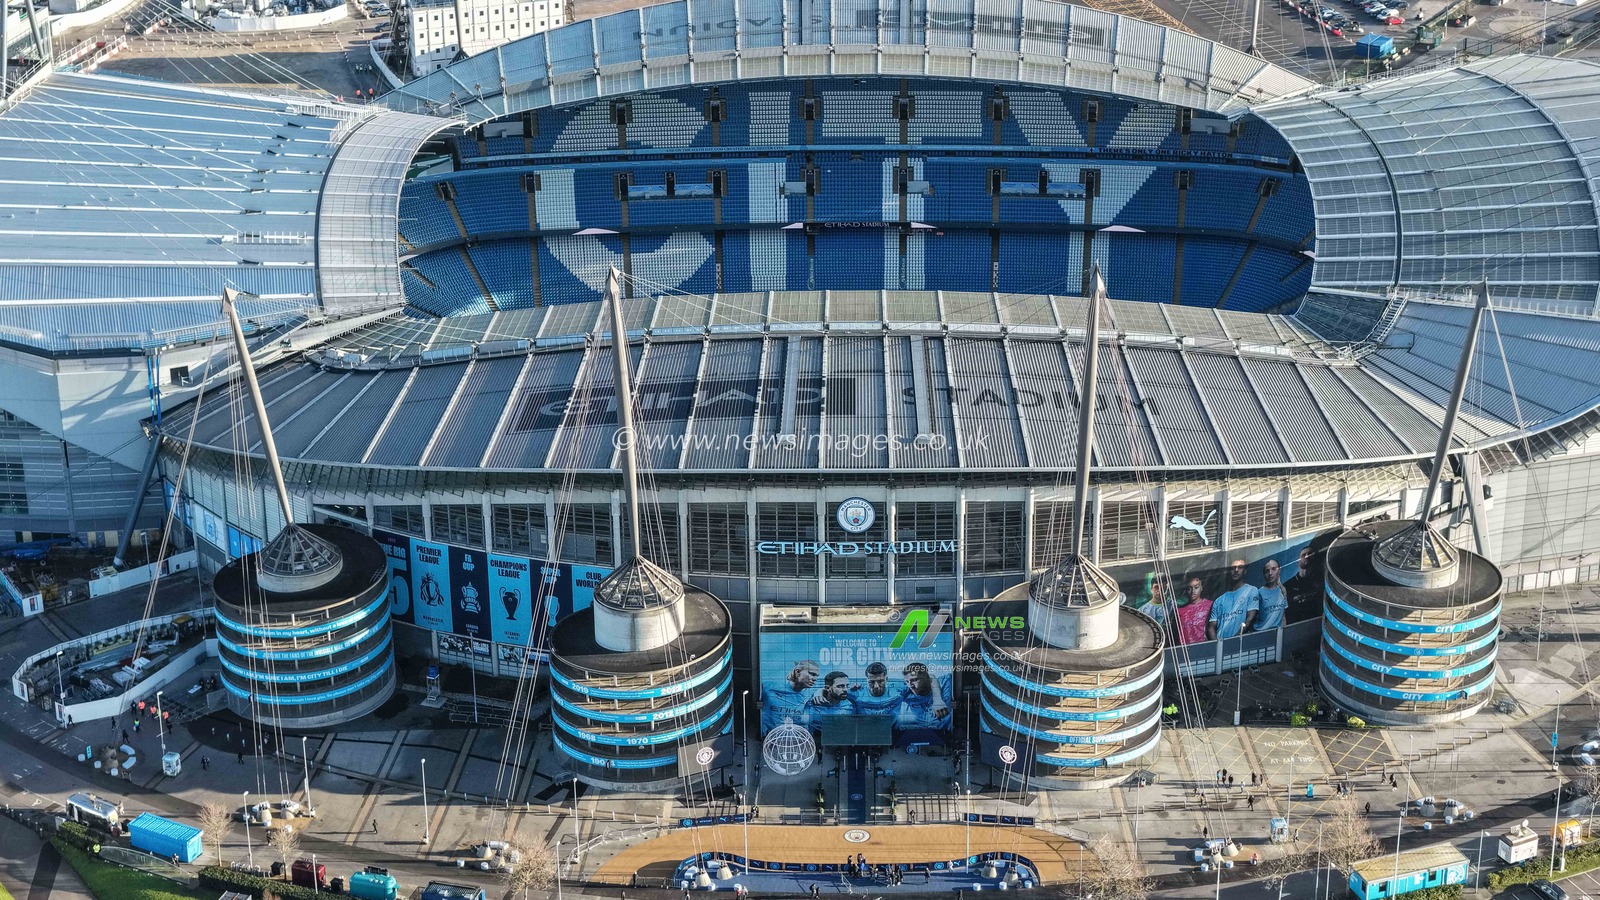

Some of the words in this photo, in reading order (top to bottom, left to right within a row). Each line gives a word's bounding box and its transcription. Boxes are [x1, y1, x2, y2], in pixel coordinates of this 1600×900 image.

[841, 500, 872, 511] MANCHESTER
[416, 544, 442, 557] PREMIER
[757, 541, 859, 555] ETIHAD
[864, 540, 955, 554] STADIUM
[418, 554, 440, 565] LEAGUE
[464, 554, 473, 562] FA
[462, 562, 475, 571] CUP
[490, 559, 528, 572] CHAMPIONS
[498, 568, 521, 579] LEAGUE
[585, 571, 602, 581] CLUB
[1329, 591, 1340, 604] CITY
[310, 625, 332, 633] without
[1435, 625, 1456, 633] CITY
[1346, 629, 1363, 642] CITY
[835, 639, 867, 647] WELCOME
[819, 647, 854, 666] OUR
[856, 647, 893, 666] CITY
[322, 669, 335, 677] TILL
[1371, 663, 1392, 674] CITY
[572, 679, 588, 694] 2019
[1402, 692, 1424, 700] CITY
[652, 709, 675, 721] 2012
[577, 731, 596, 741] 1968
[626, 737, 648, 746] 1970
[1069, 735, 1091, 744] OFFICIAL
